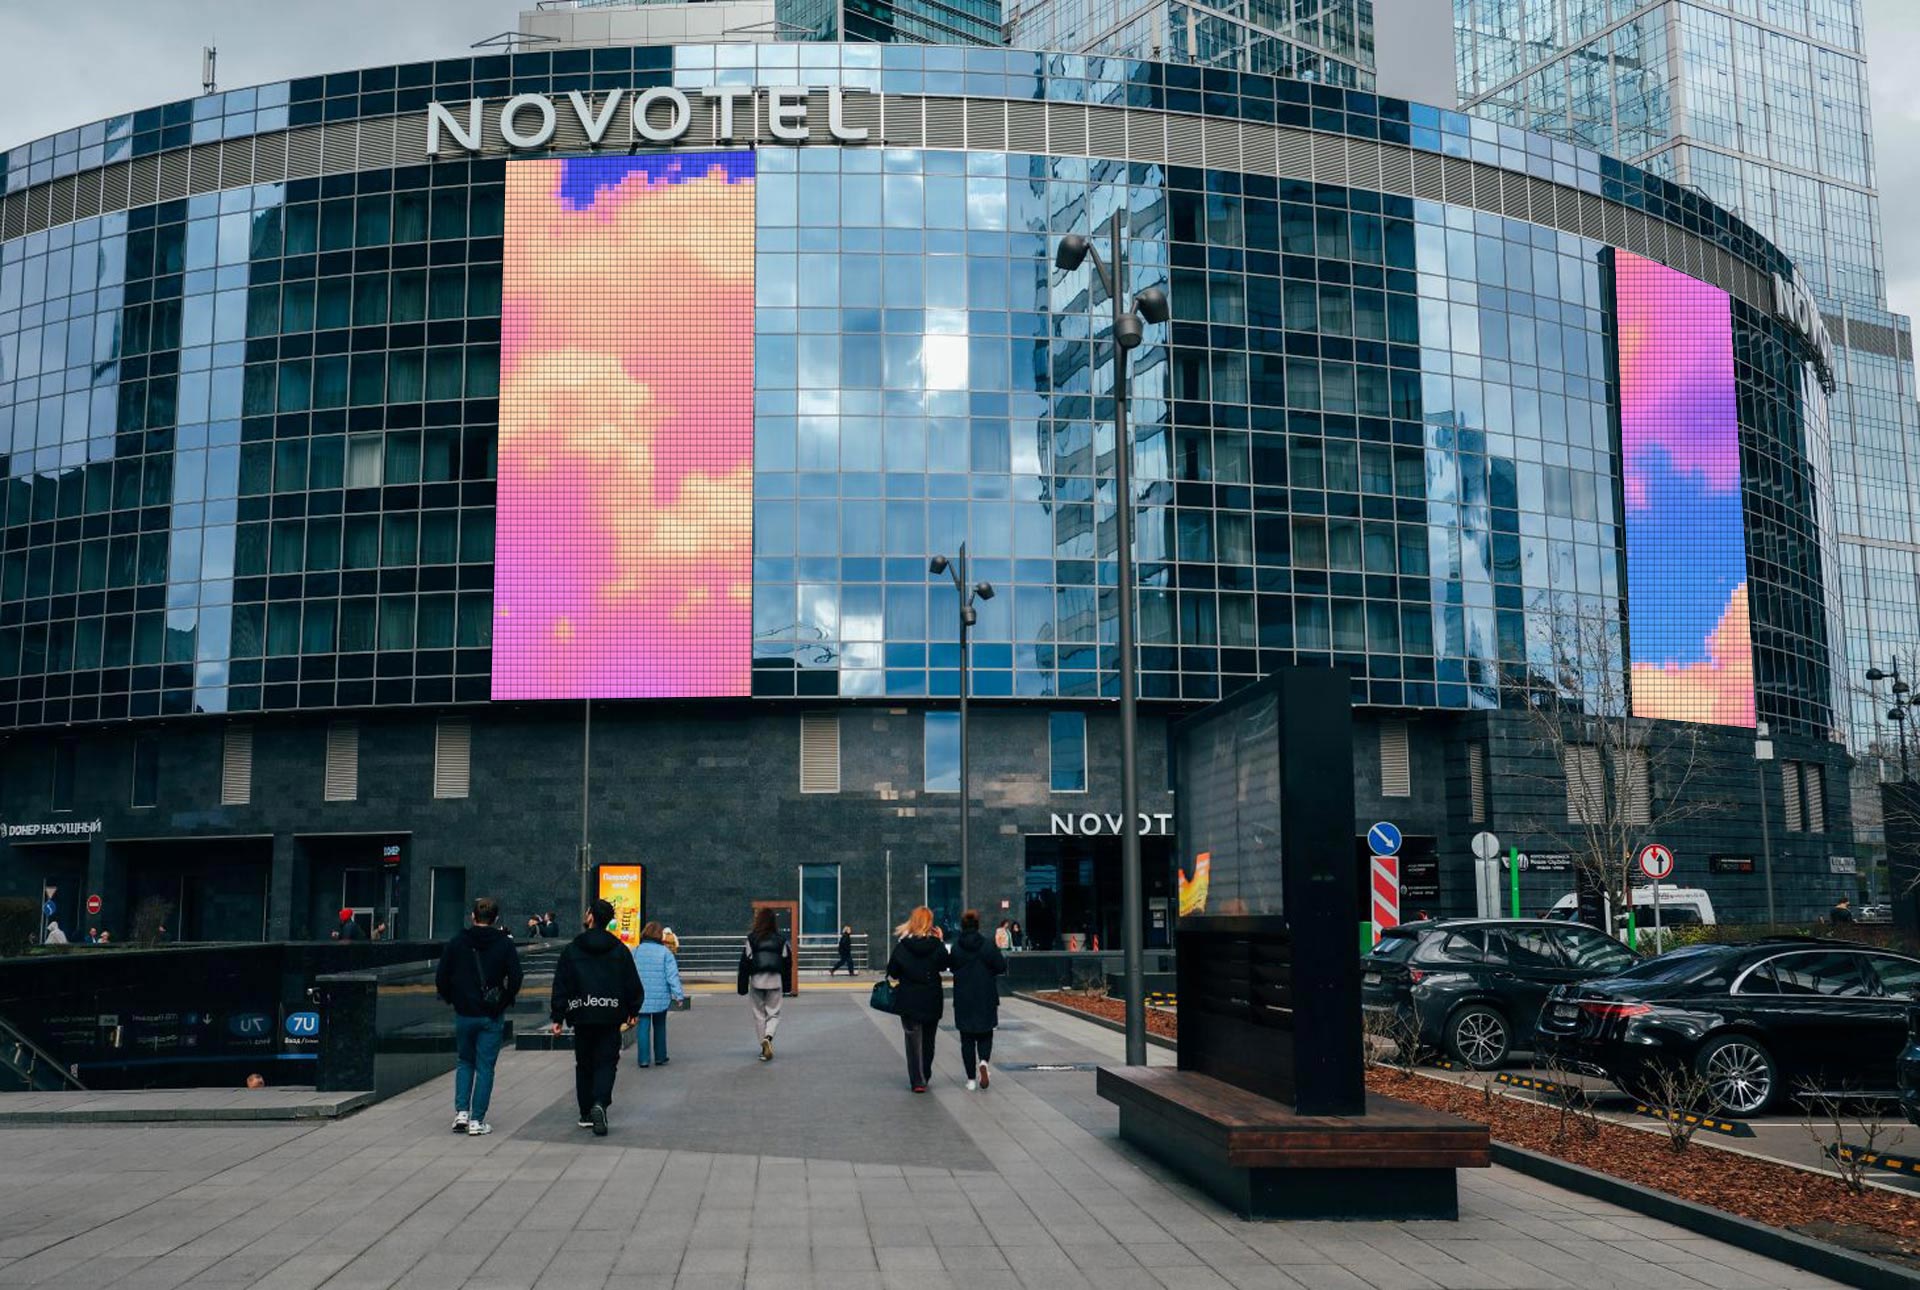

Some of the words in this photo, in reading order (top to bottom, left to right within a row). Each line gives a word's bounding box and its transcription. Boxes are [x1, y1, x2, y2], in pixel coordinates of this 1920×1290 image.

[427, 86, 869, 155] NOVOTEL
[41, 818, 102, 835] НАСУЩНЫЙ
[583, 994, 619, 1008] Jeans
[293, 1017, 315, 1031] 7U
